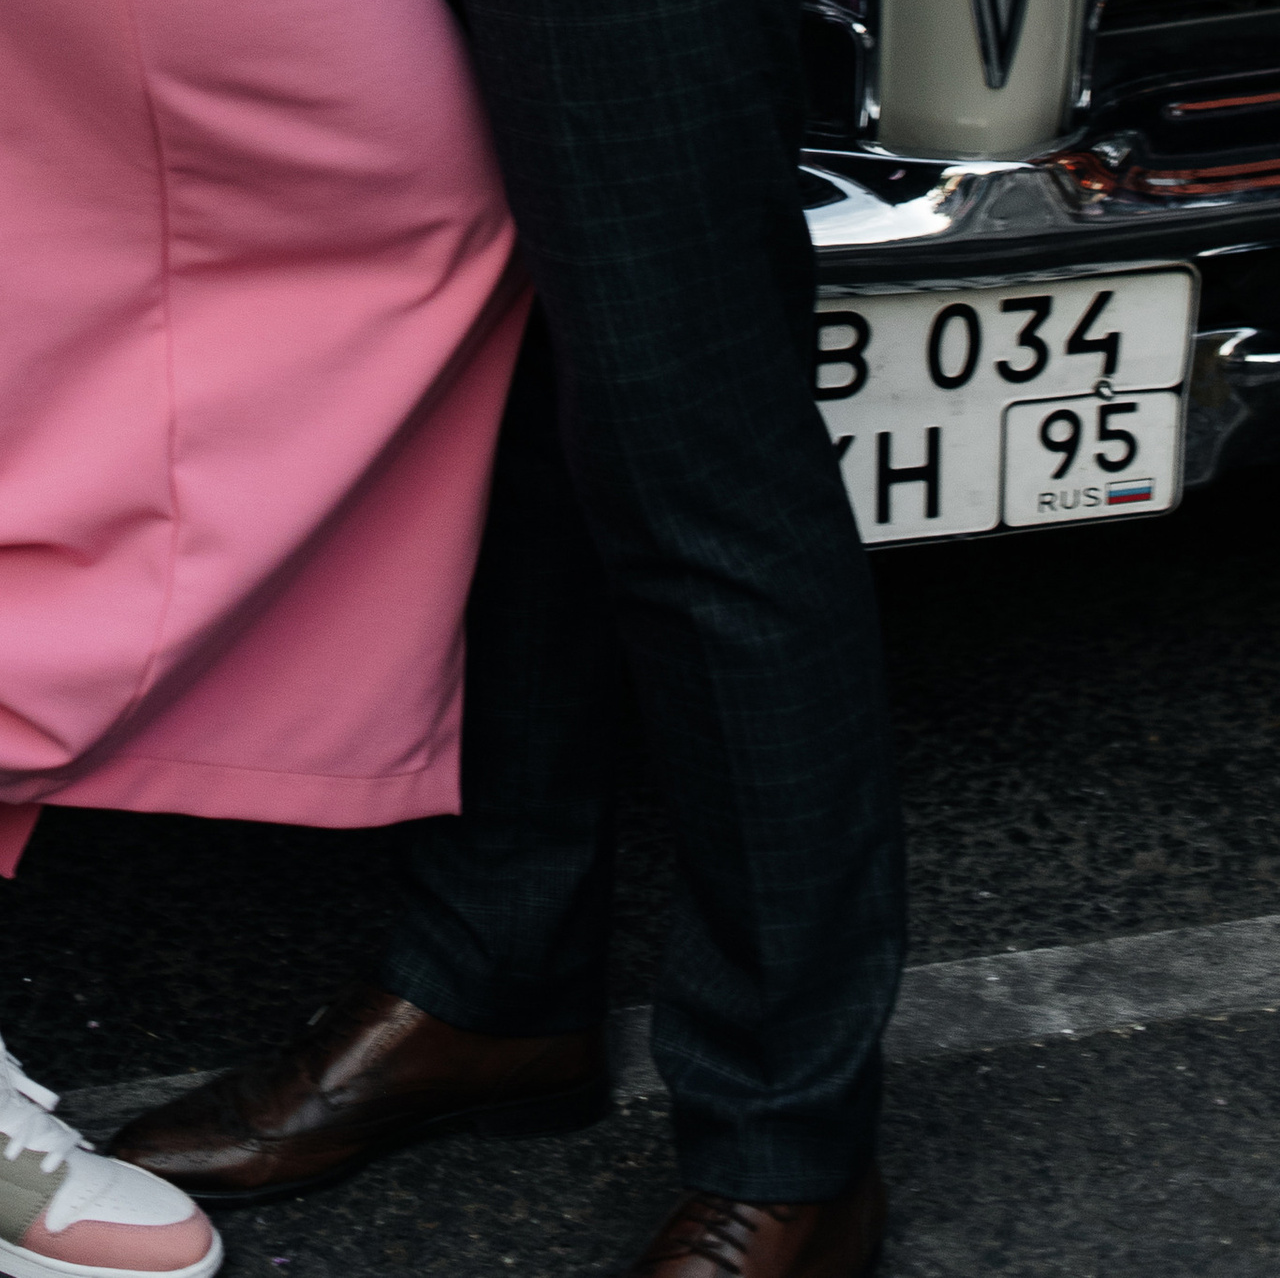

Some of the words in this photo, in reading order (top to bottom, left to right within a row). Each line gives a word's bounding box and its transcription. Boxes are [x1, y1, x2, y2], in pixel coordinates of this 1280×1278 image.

[927, 290, 1121, 390] 034
[1039, 402, 1139, 480] 95
[1037, 485, 1103, 514] RUS
